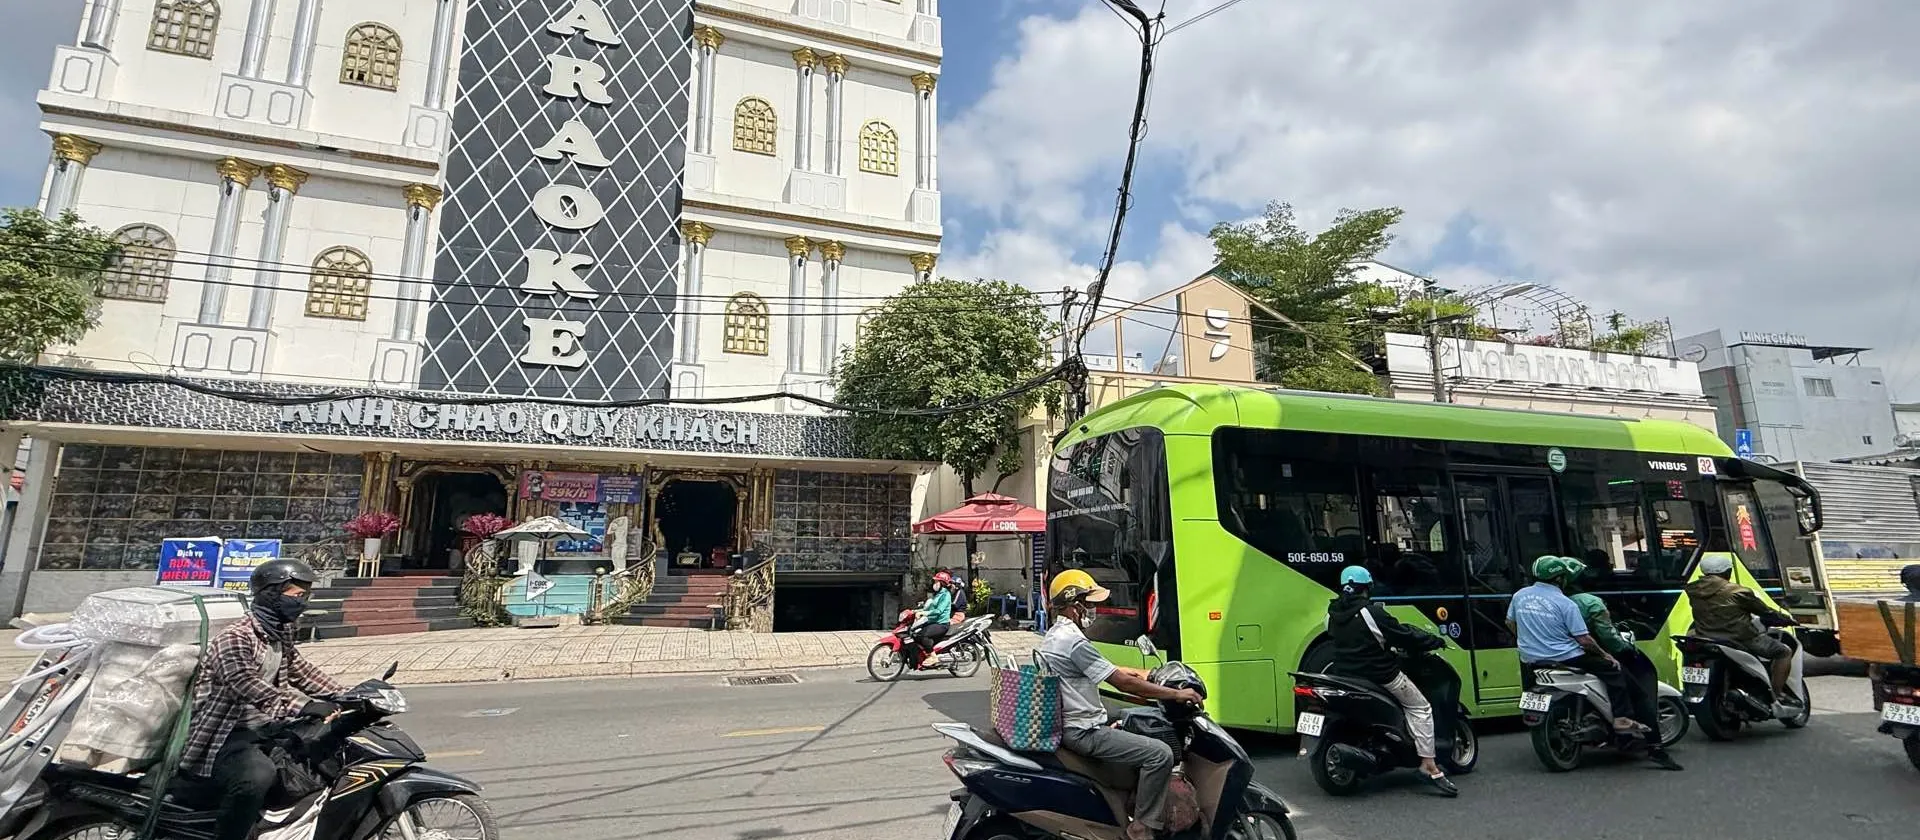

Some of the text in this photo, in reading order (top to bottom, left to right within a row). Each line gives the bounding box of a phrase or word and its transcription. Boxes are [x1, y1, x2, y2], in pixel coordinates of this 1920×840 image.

[635, 412, 758, 445] KHÁCH
[1647, 460, 1688, 472] VINBUS
[1699, 458, 1713, 473] 32
[177, 549, 193, 558] Dịch
[1287, 552, 1345, 563] 50E-650.59
